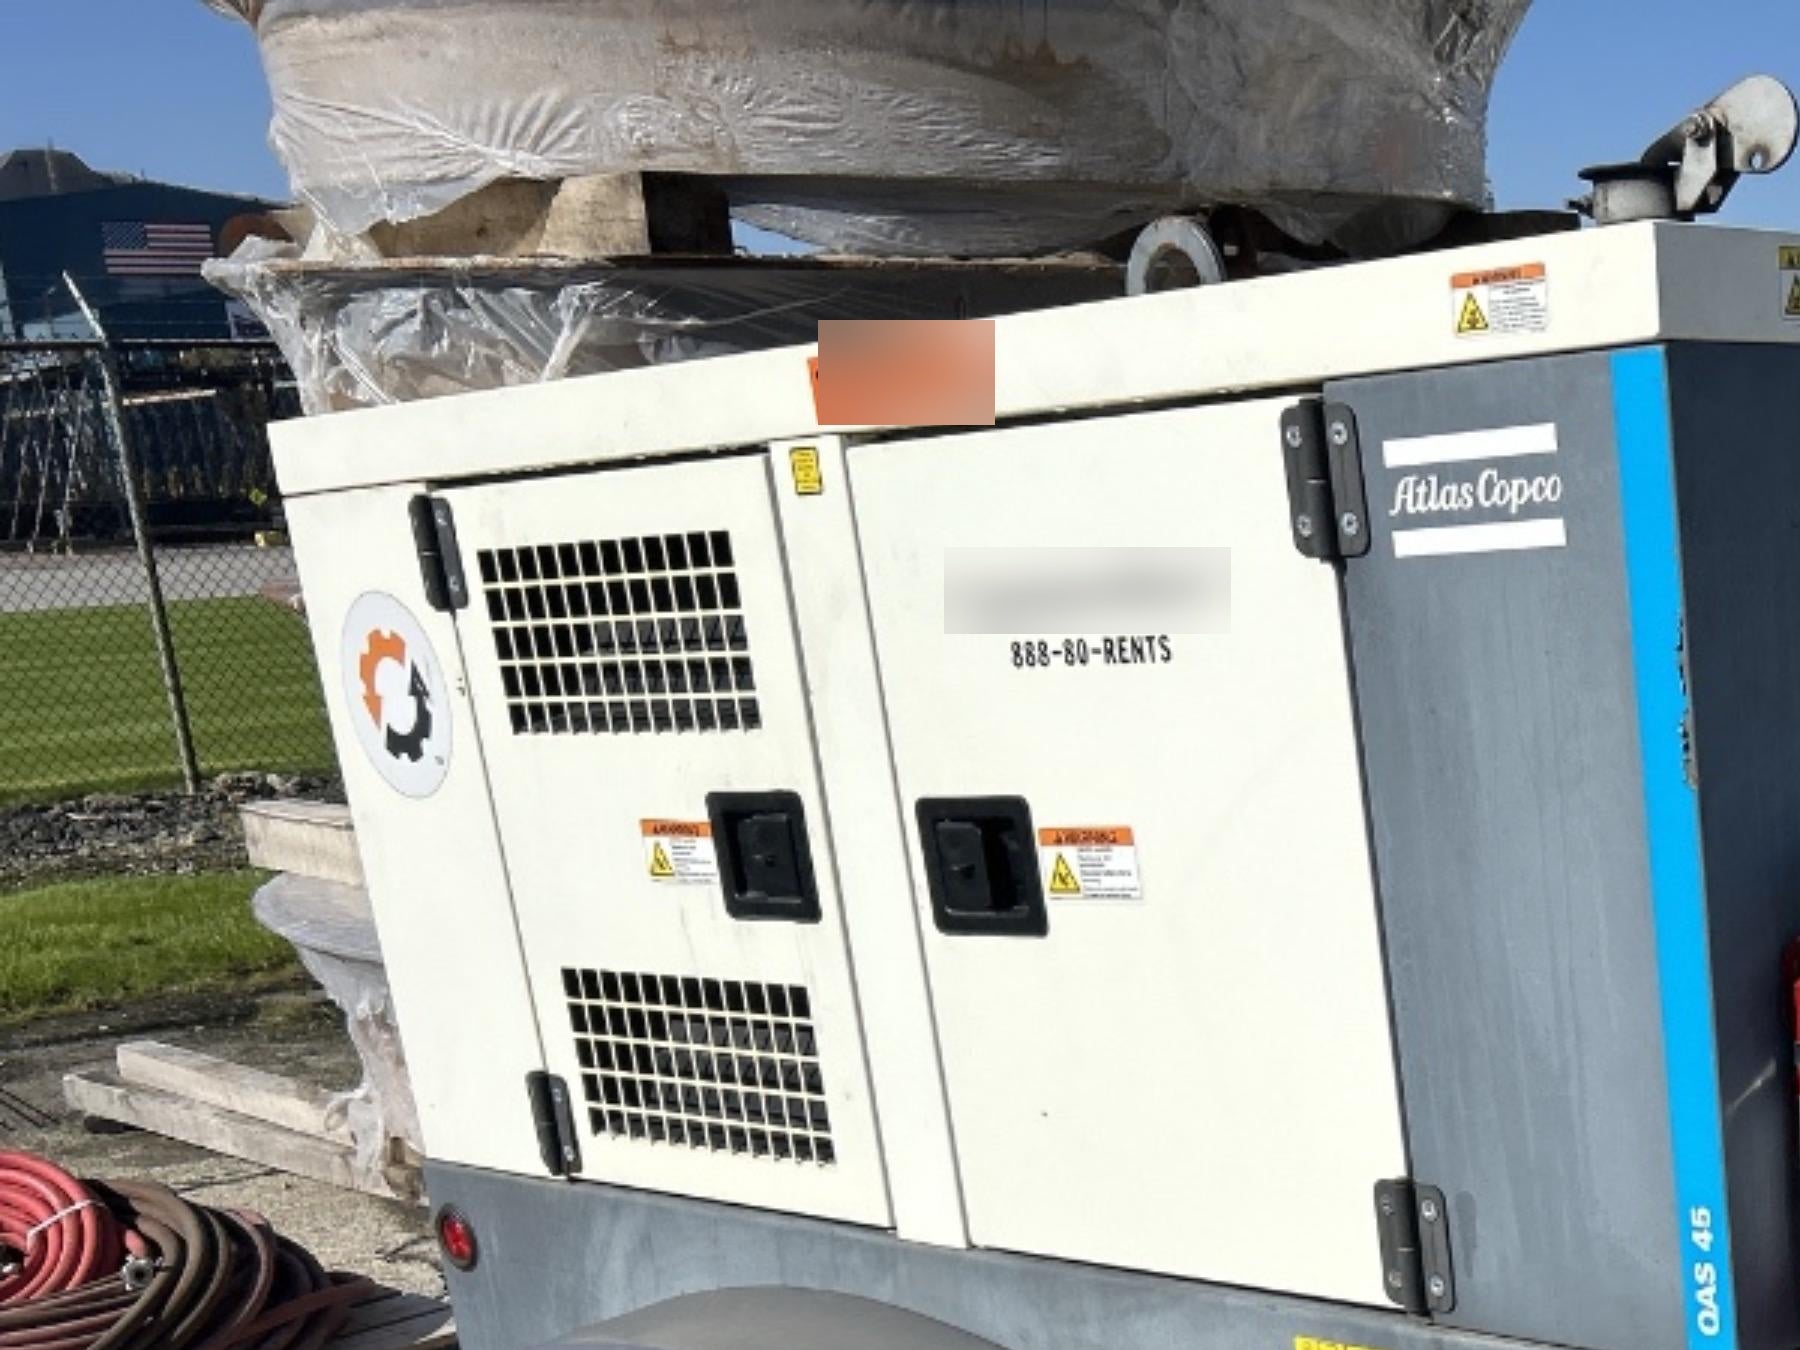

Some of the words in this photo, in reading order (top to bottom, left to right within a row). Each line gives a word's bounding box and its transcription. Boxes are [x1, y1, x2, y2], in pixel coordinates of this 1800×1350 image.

[1389, 474, 1474, 517] Atlas
[1478, 466, 1562, 513] Copco
[1010, 635, 1173, 670] 888-80-RENTS
[1691, 1205, 1714, 1252] 45
[1696, 1262, 1720, 1336] QAS
